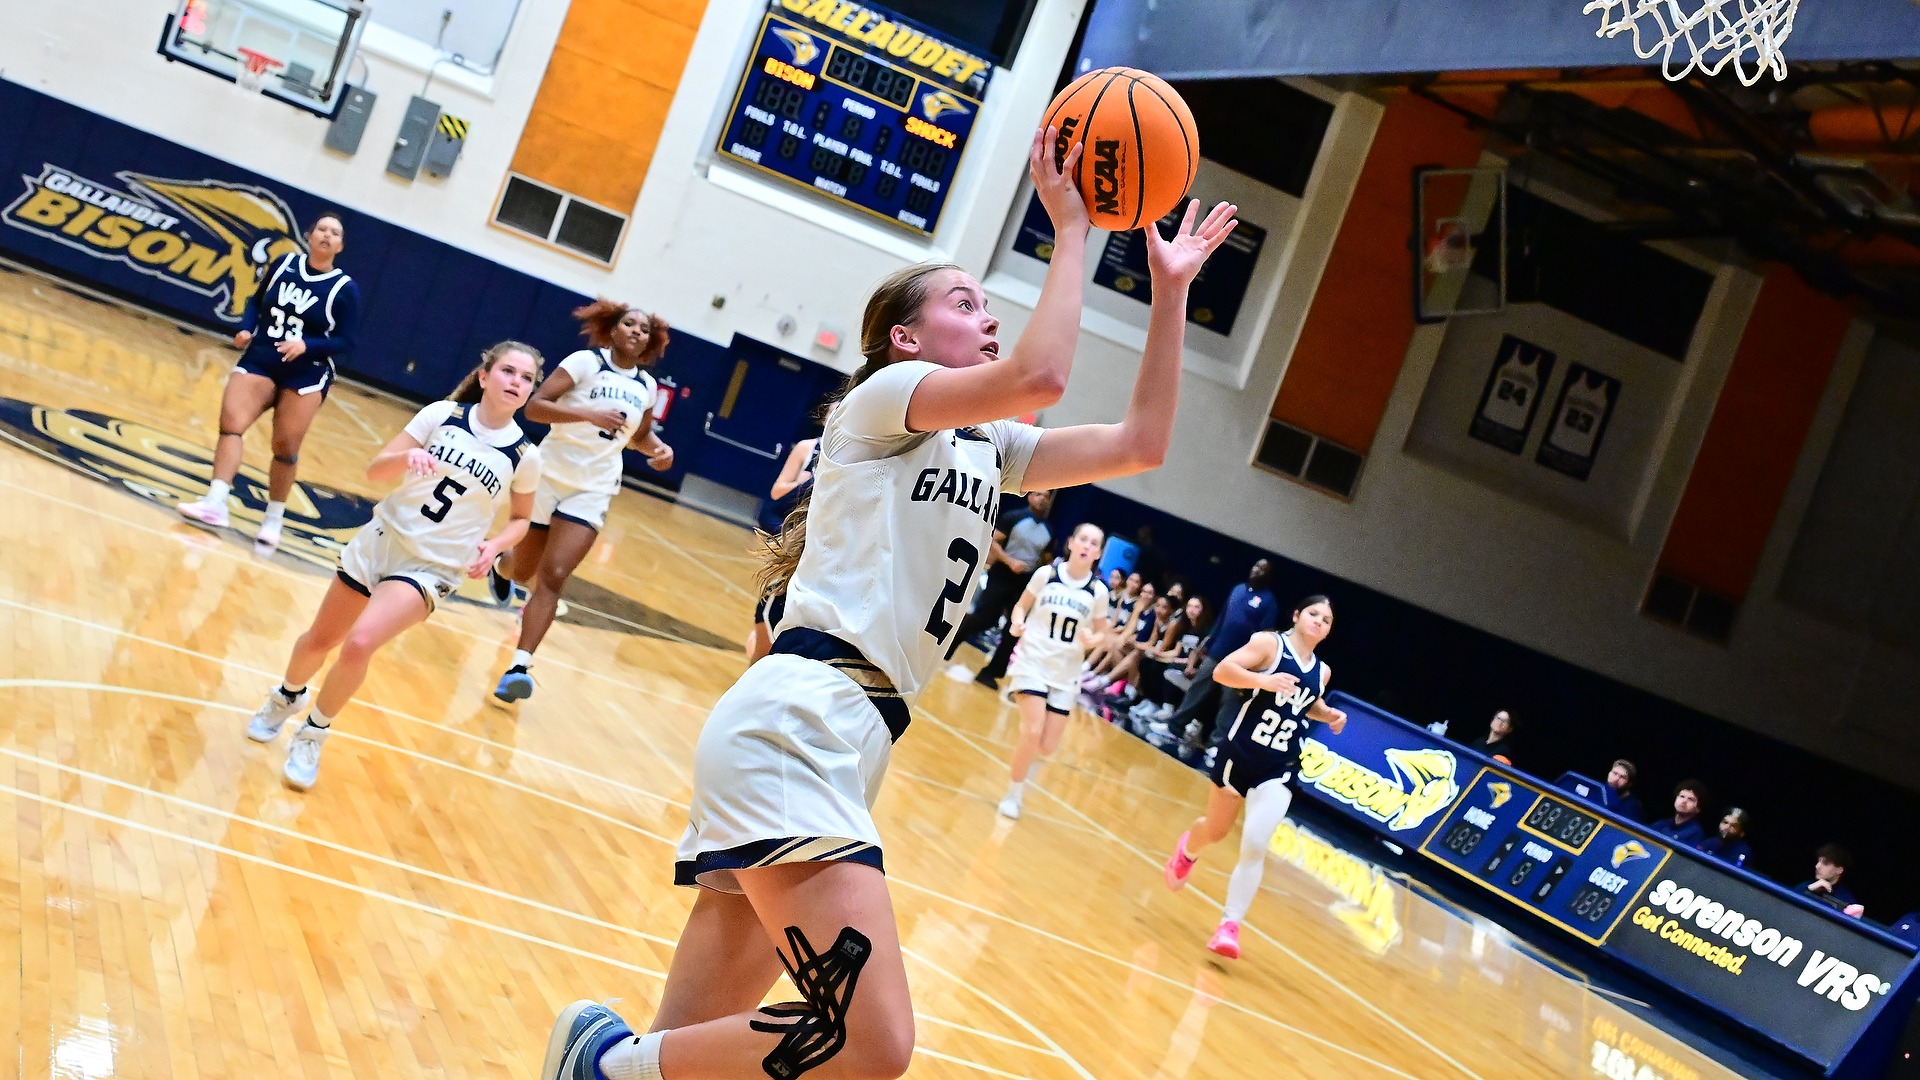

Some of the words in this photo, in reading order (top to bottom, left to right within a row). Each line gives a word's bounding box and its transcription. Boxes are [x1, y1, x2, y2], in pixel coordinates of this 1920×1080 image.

[764, 57, 816, 91] BISON
[904, 116, 957, 149] SHOCK
[44, 171, 181, 231] GALLAUDET
[1093, 139, 1120, 217] NCAA
[15, 186, 233, 286] BISON
[266, 306, 305, 342] 33
[420, 475, 468, 523] 5
[923, 536, 979, 646] 2
[1049, 612, 1079, 643] 10
[1250, 708, 1298, 752] 22
[1319, 761, 1411, 818] BISON
[1463, 805, 1496, 831] HOME
[1589, 866, 1629, 895] GUEST
[1632, 905, 1664, 934] Get
[1659, 918, 1749, 976] Connected.
[1648, 878, 1803, 968] sorenson
